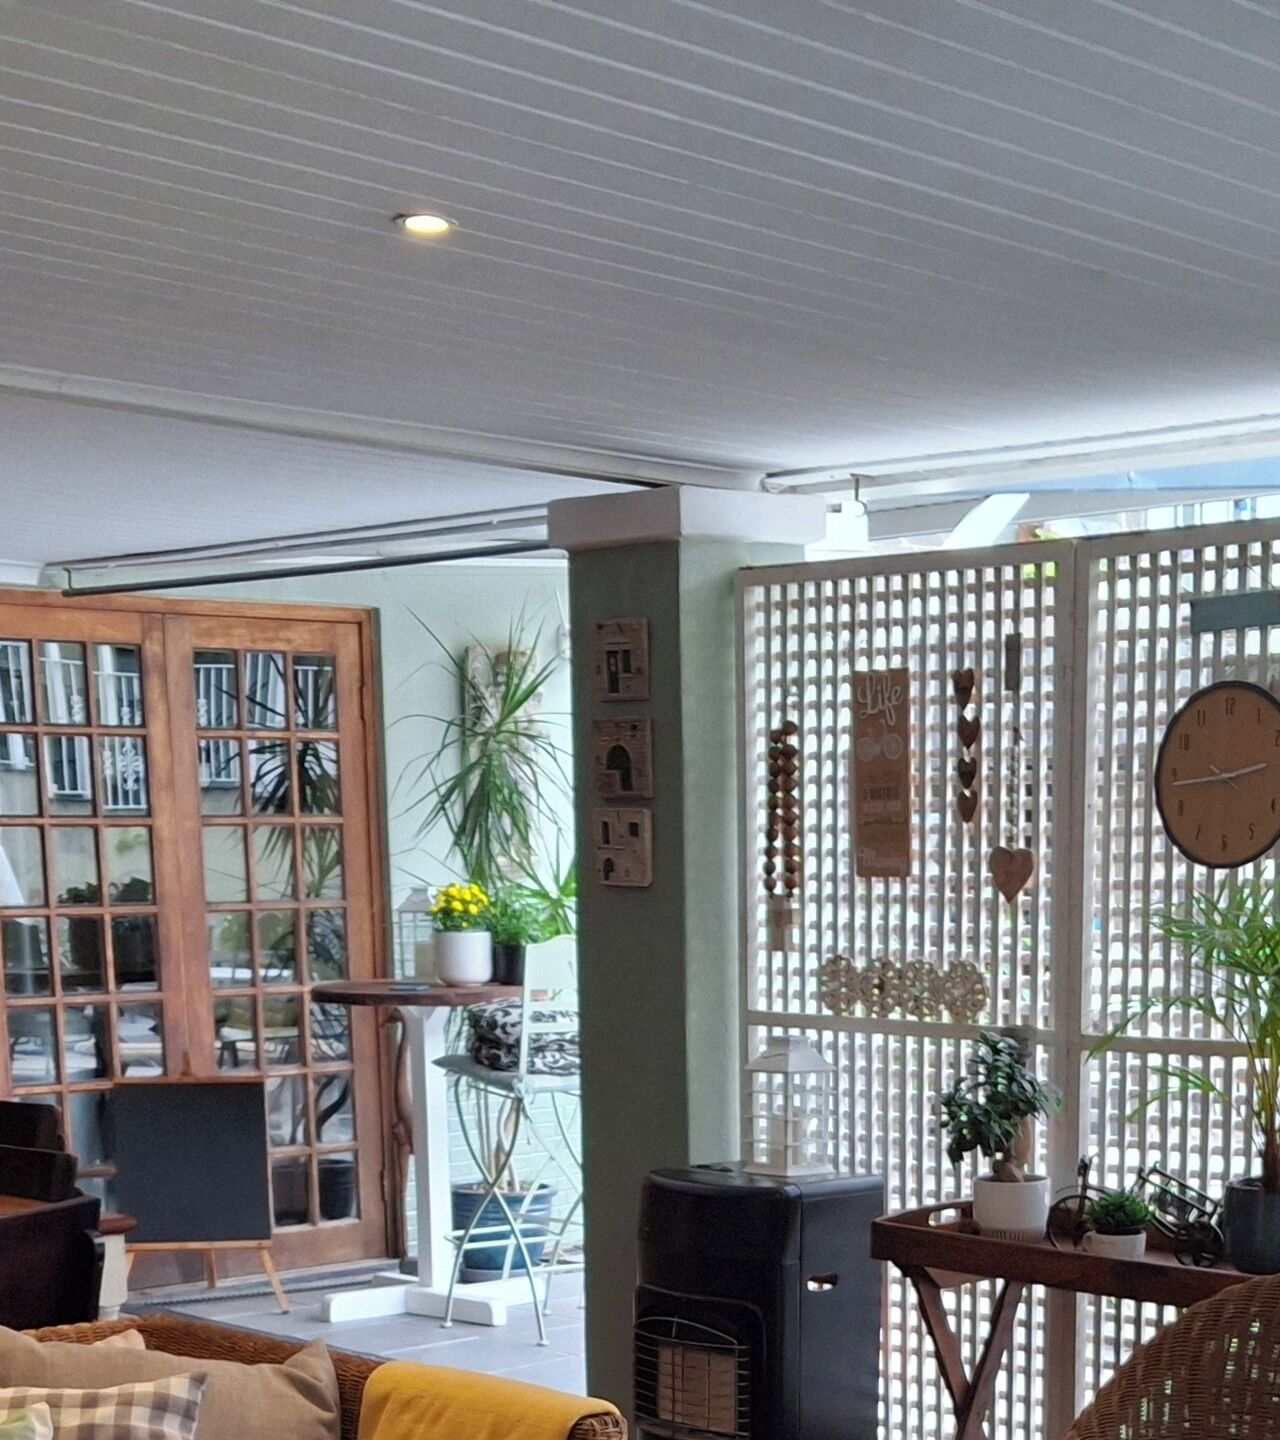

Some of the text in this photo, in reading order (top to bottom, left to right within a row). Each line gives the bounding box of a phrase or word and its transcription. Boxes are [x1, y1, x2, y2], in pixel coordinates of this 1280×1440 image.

[856, 672, 906, 728] Life
[1225, 697, 1236, 716] 12
[1196, 709, 1207, 727] 11
[1178, 733, 1190, 751] 10
[1177, 799, 1184, 817] 8
[1270, 797, 1276, 815] 4
[1195, 823, 1202, 841] 7
[1248, 822, 1256, 841] 5
[1220, 834, 1228, 852] 6
